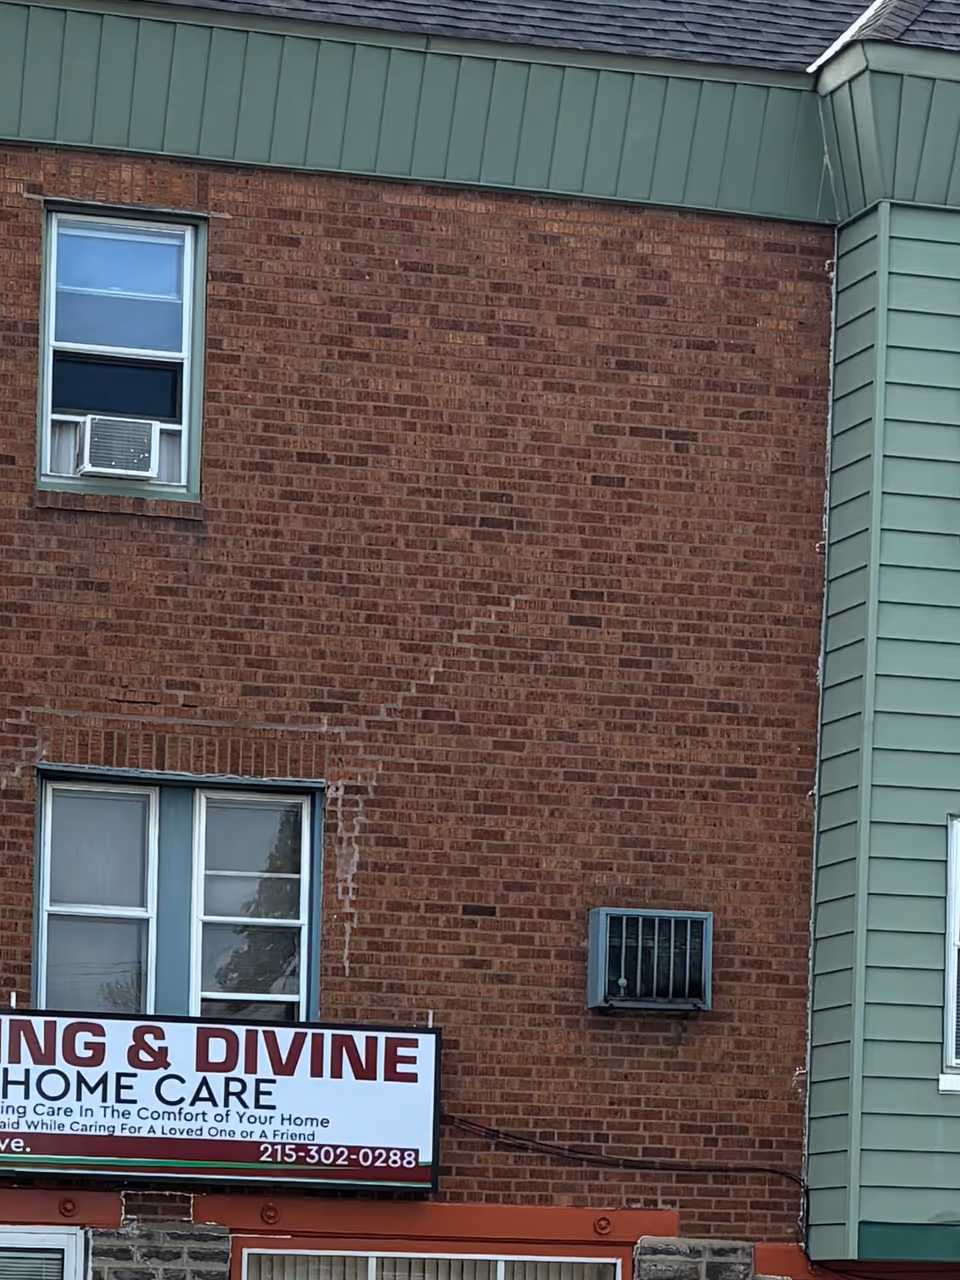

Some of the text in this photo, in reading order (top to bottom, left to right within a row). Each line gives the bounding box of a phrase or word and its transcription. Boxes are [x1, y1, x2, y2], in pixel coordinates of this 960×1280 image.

[126, 1025, 171, 1070] &
[195, 1026, 419, 1083] DIVINE
[1, 1067, 277, 1110] HOME CARE
[33, 1103, 73, 1117] Care
[80, 1105, 94, 1118] In
[100, 1105, 130, 1119] The
[137, 1107, 208, 1122] Comfort
[214, 1110, 230, 1123] of
[236, 1111, 275, 1125] Your
[281, 1114, 330, 1128] Home
[26, 1120, 65, 1132] While
[69, 1121, 115, 1135] Caring
[121, 1123, 143, 1134] For
[147, 1125, 156, 1135] A
[161, 1125, 203, 1137] Loved
[208, 1127, 236, 1138] One
[240, 1130, 255, 1139] or
[259, 1129, 268, 1140] A
[273, 1129, 315, 1142] Friend
[259, 1144, 417, 1168] 215-302-0288
